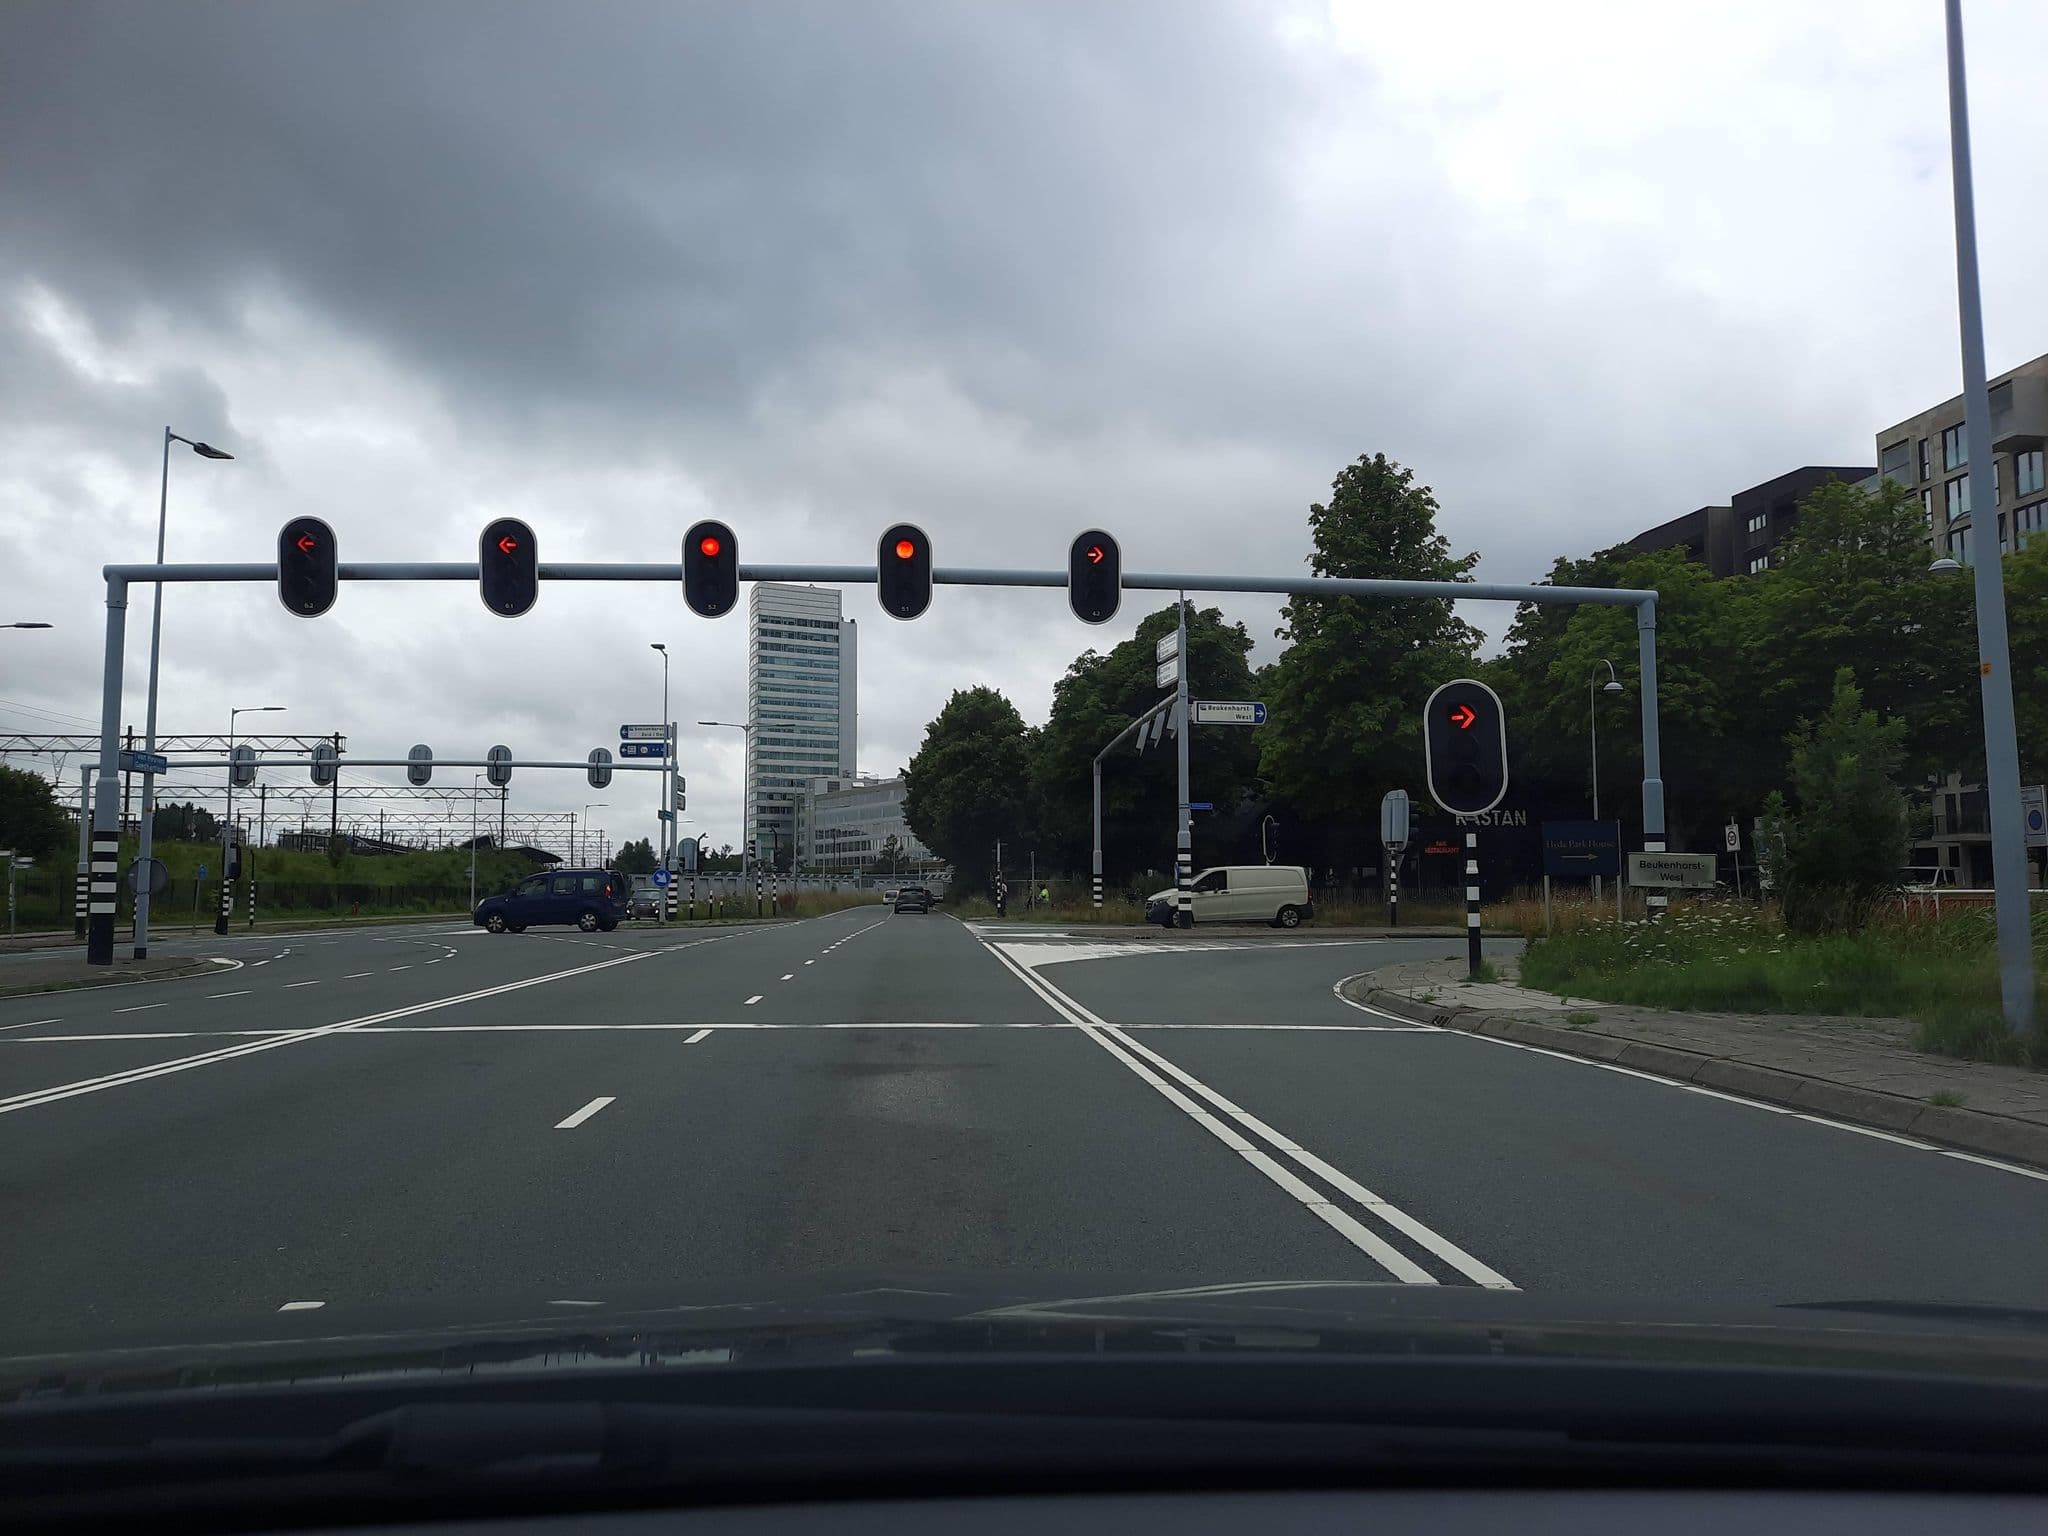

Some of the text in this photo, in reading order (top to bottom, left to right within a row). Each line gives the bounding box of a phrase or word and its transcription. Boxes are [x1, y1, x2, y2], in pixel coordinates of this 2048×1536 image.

[1569, 840, 1587, 849] Park
[1588, 840, 1616, 849] House
[1639, 860, 1705, 870] Beukenhorst-
[1660, 873, 1683, 882] West
